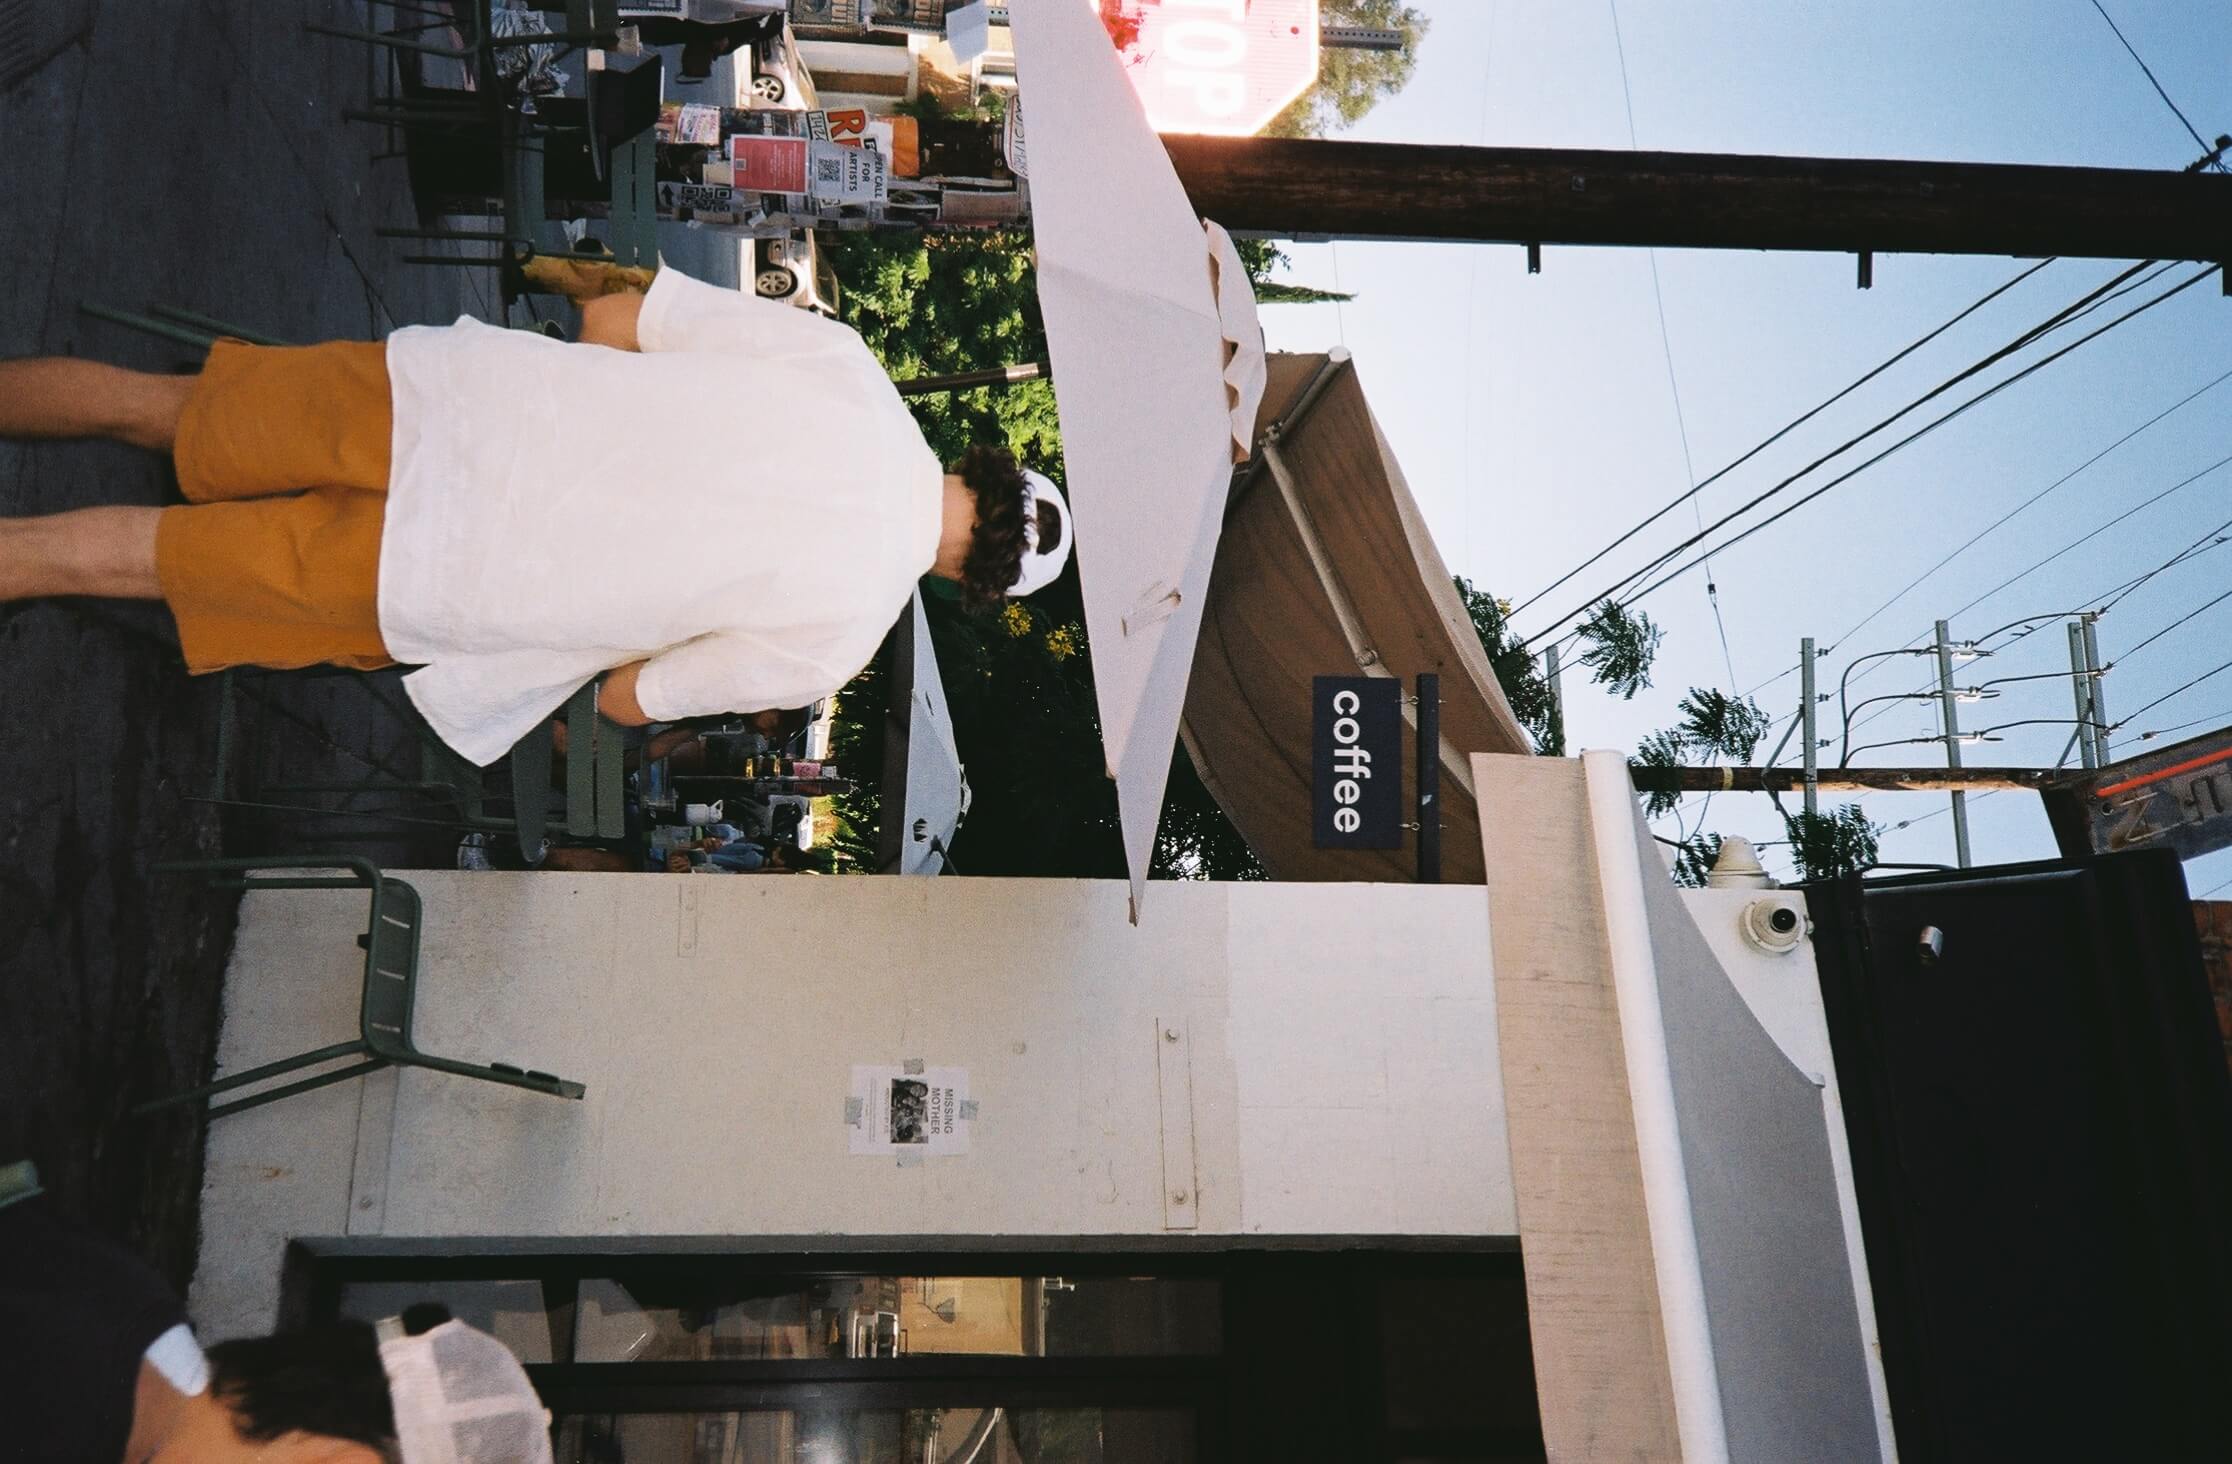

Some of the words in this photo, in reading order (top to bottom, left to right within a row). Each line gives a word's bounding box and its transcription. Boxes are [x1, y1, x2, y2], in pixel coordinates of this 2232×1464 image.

[1162, 0, 1247, 116] TOP
[849, 152, 858, 192] ARTISTS
[862, 162, 871, 182] FOR
[874, 175, 883, 199] CALL
[1333, 690, 1371, 833] coffee
[931, 1088, 940, 1134] MOTHER
[944, 1088, 953, 1134] MISSING
